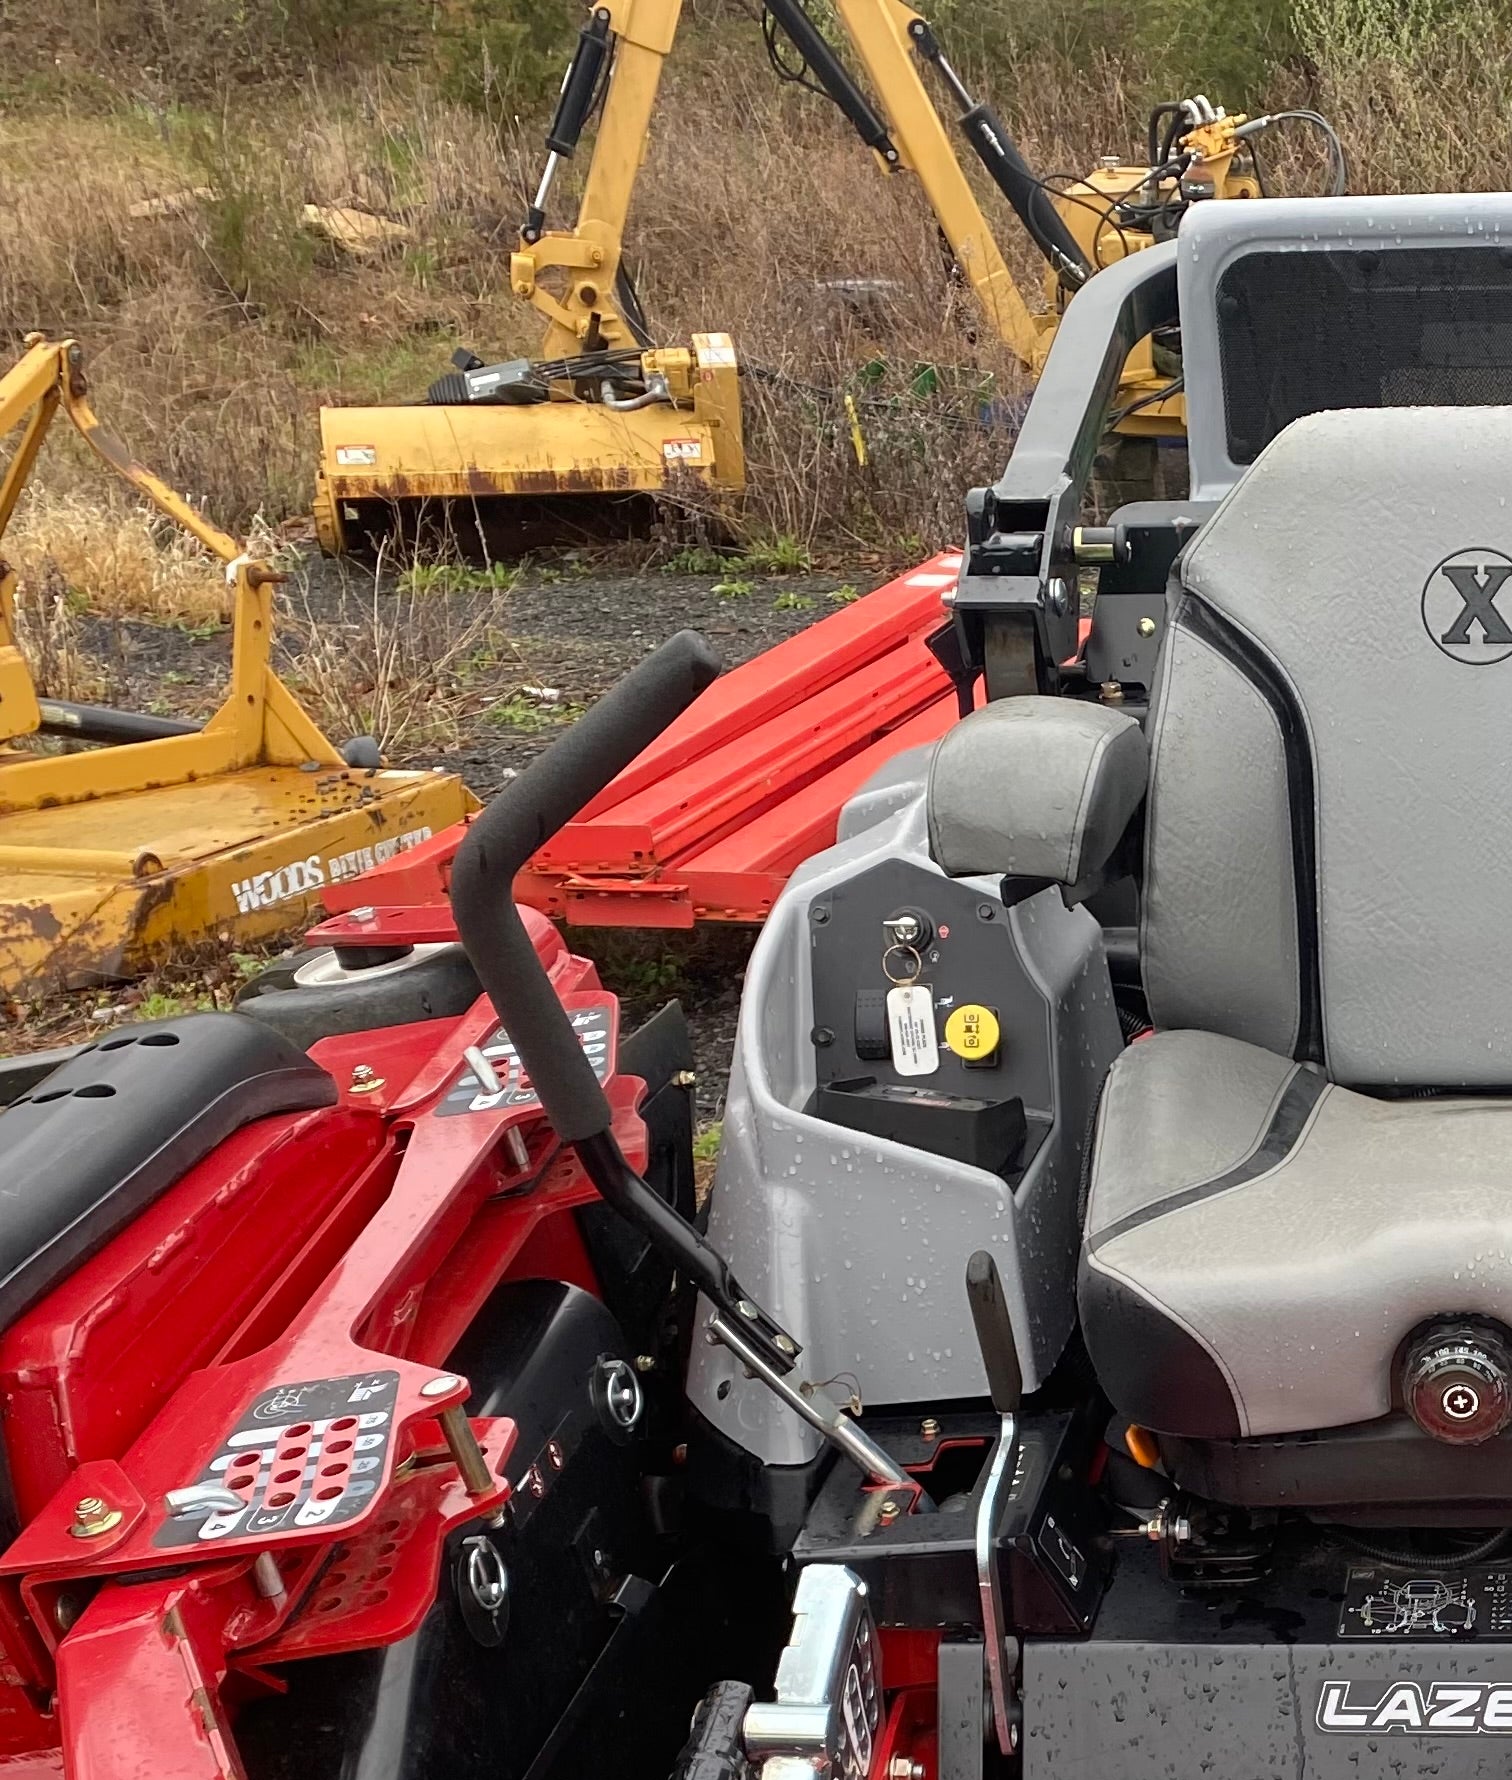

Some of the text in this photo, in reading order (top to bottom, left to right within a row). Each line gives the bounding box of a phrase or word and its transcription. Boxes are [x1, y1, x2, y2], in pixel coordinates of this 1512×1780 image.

[230, 855, 325, 914] WOODS
[256, 1514, 279, 1525] 3
[210, 1523, 226, 1531] 4
